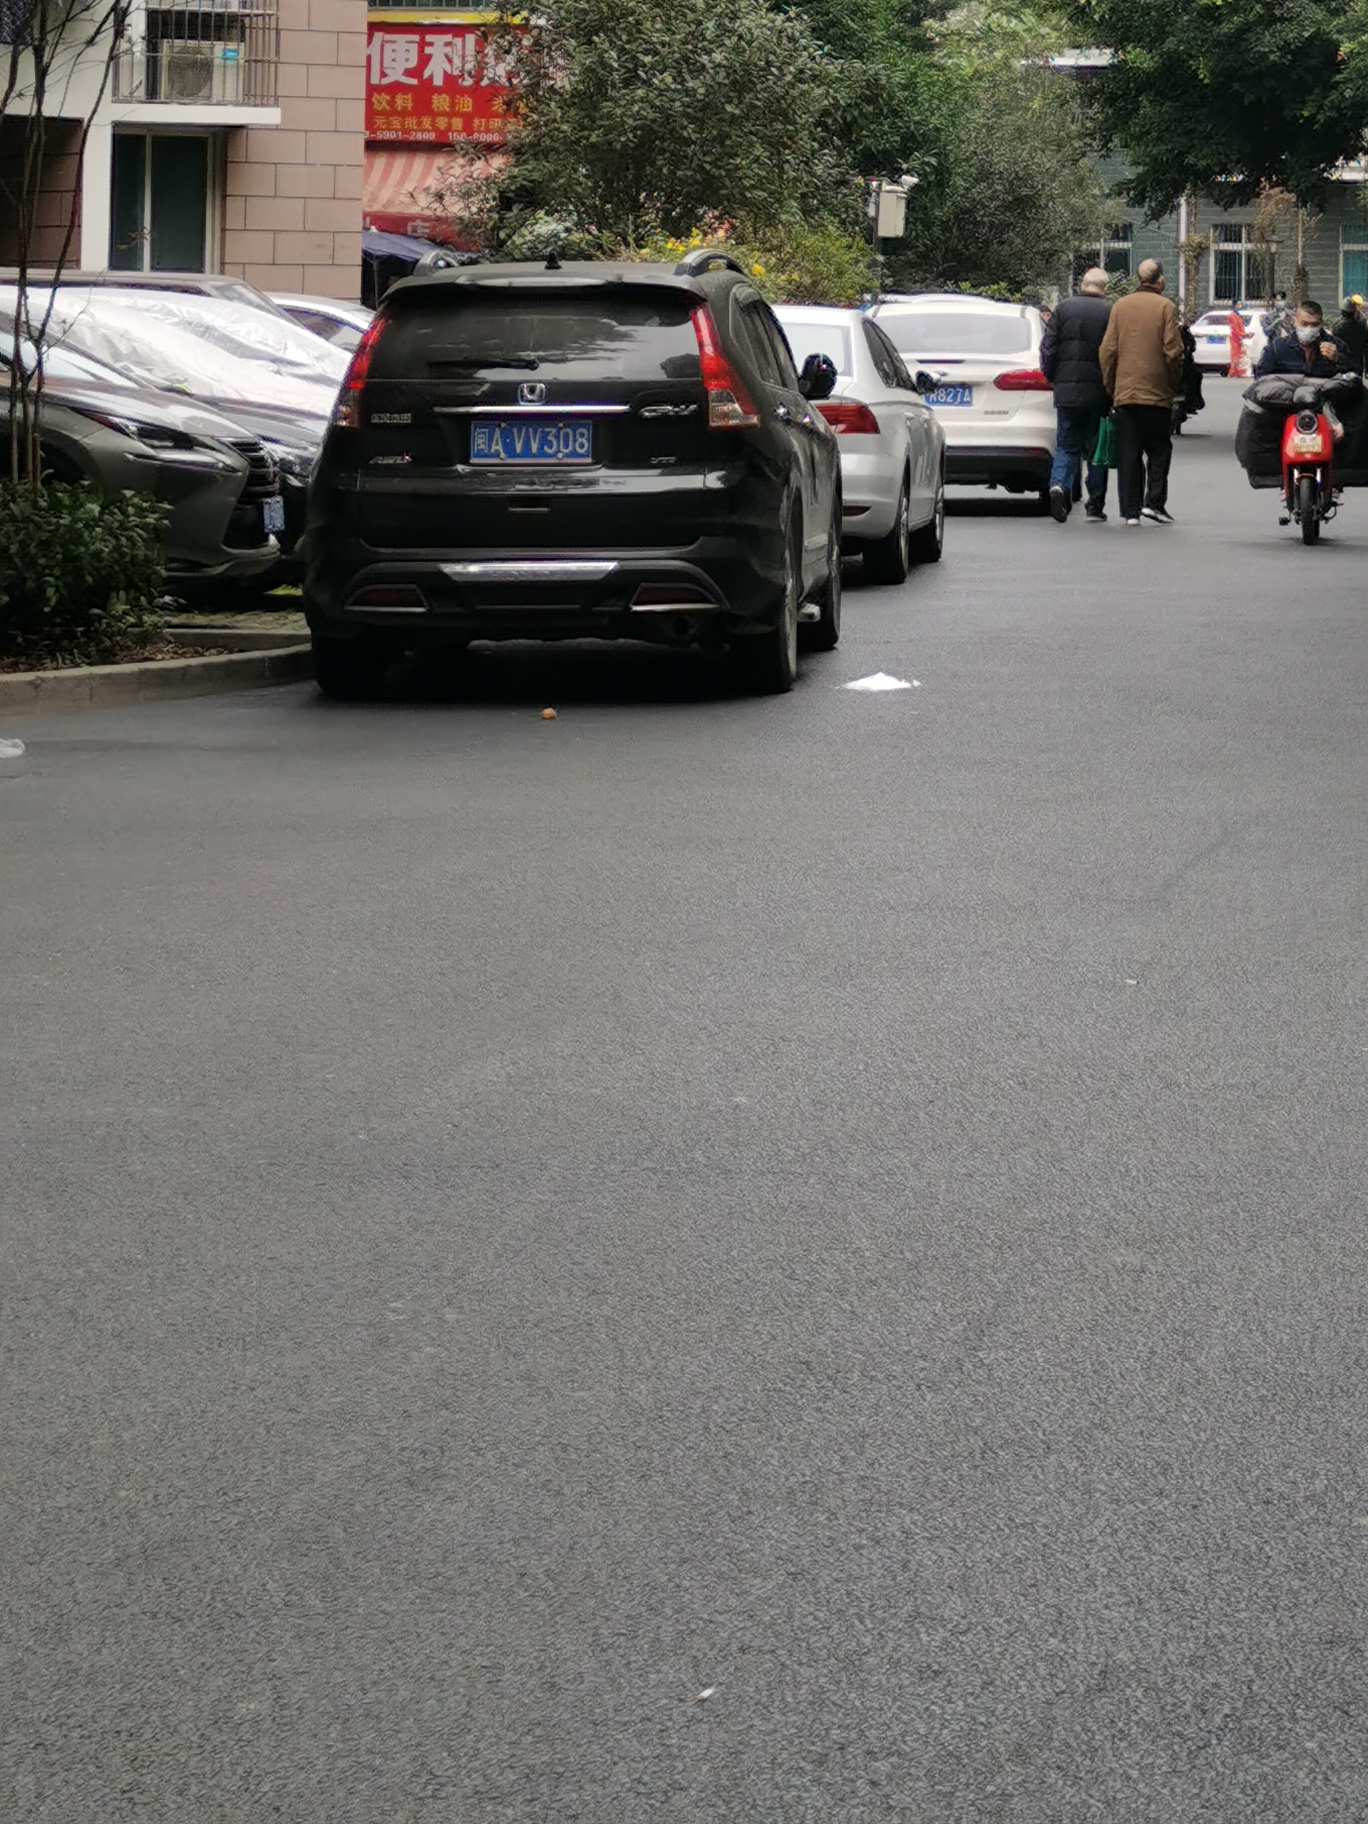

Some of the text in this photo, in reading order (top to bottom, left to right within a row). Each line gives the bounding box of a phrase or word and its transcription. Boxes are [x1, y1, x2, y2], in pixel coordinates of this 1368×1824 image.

[366, 32, 533, 87] 便利
[371, 93, 413, 111] 饮料
[431, 93, 473, 112] 粮油
